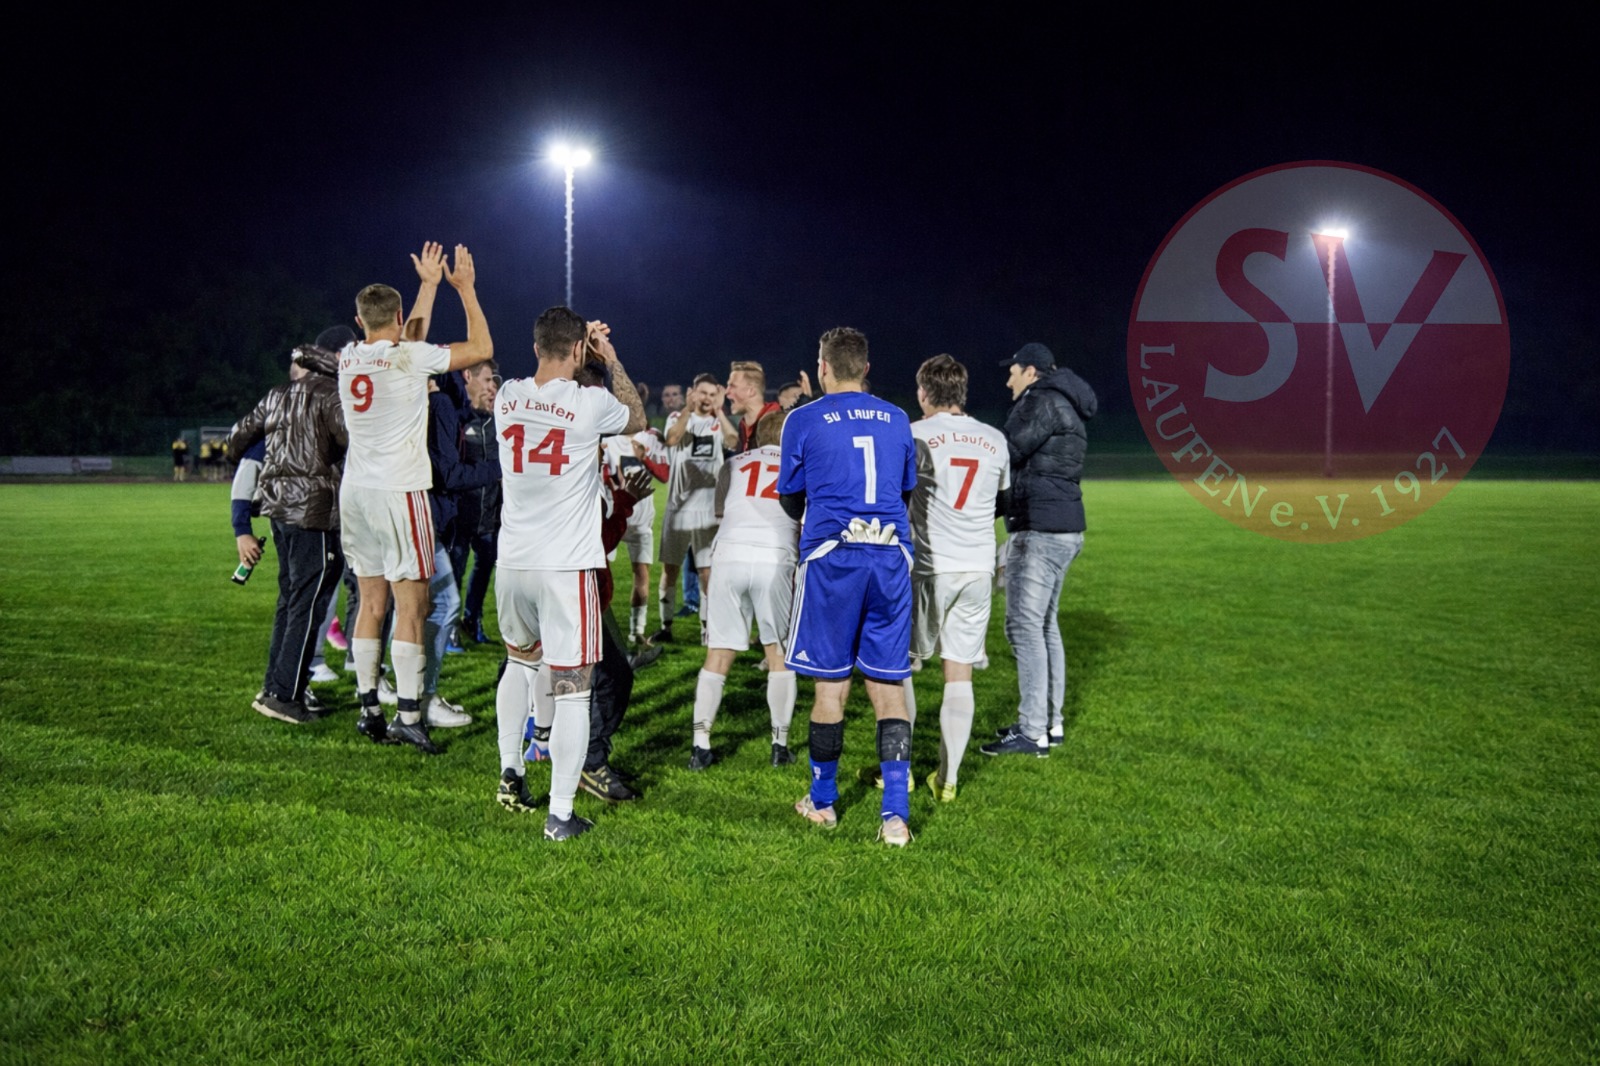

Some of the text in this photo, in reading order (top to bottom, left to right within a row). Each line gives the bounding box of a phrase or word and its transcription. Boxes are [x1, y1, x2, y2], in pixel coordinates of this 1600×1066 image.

[350, 374, 374, 413] 9
[501, 398, 575, 422] SV Laufen
[847, 409, 891, 424] LAUFEN
[501, 423, 570, 476] 14
[928, 432, 997, 455] SV Laufen
[852, 435, 877, 504] 1
[950, 457, 979, 511] 7
